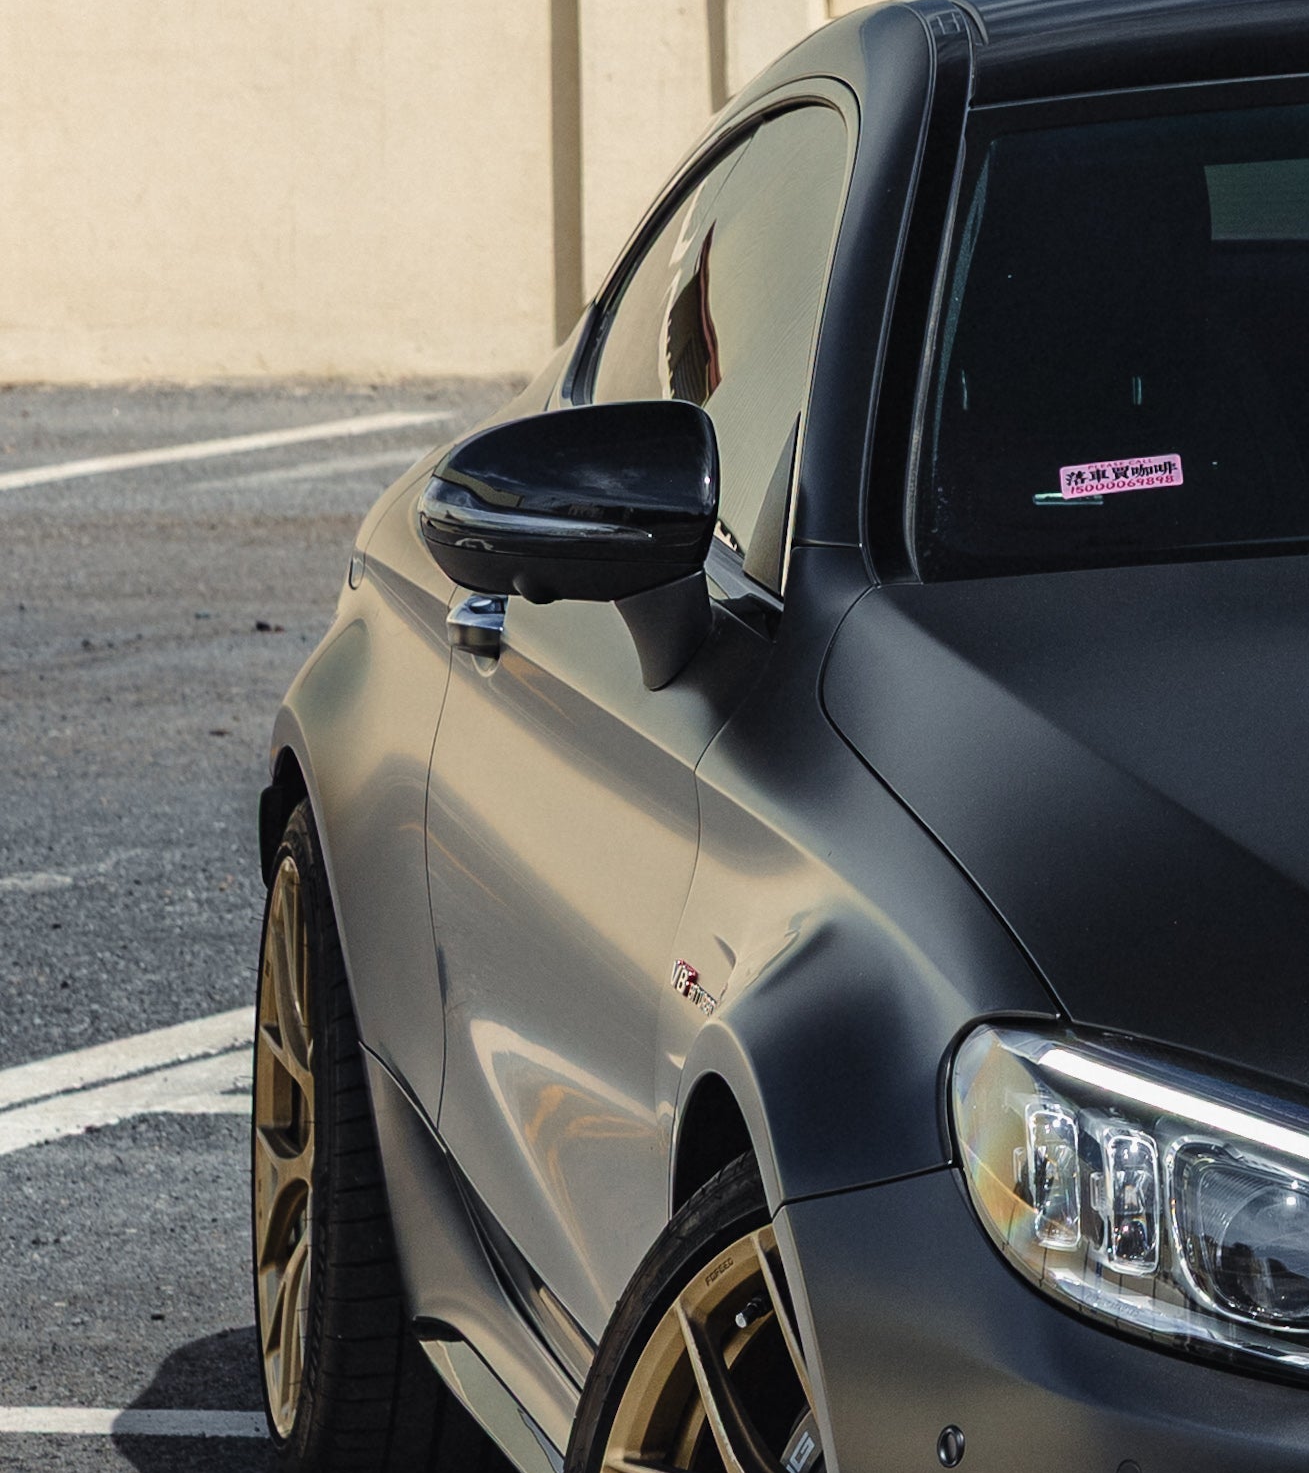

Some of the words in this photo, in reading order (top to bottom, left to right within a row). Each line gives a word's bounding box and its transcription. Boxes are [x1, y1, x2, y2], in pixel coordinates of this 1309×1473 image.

[1087, 461, 1123, 470] PLEASE
[1128, 458, 1153, 466] CALL
[1065, 461, 1178, 487] 落車買咖啡
[1070, 475, 1175, 494] 15000069898
